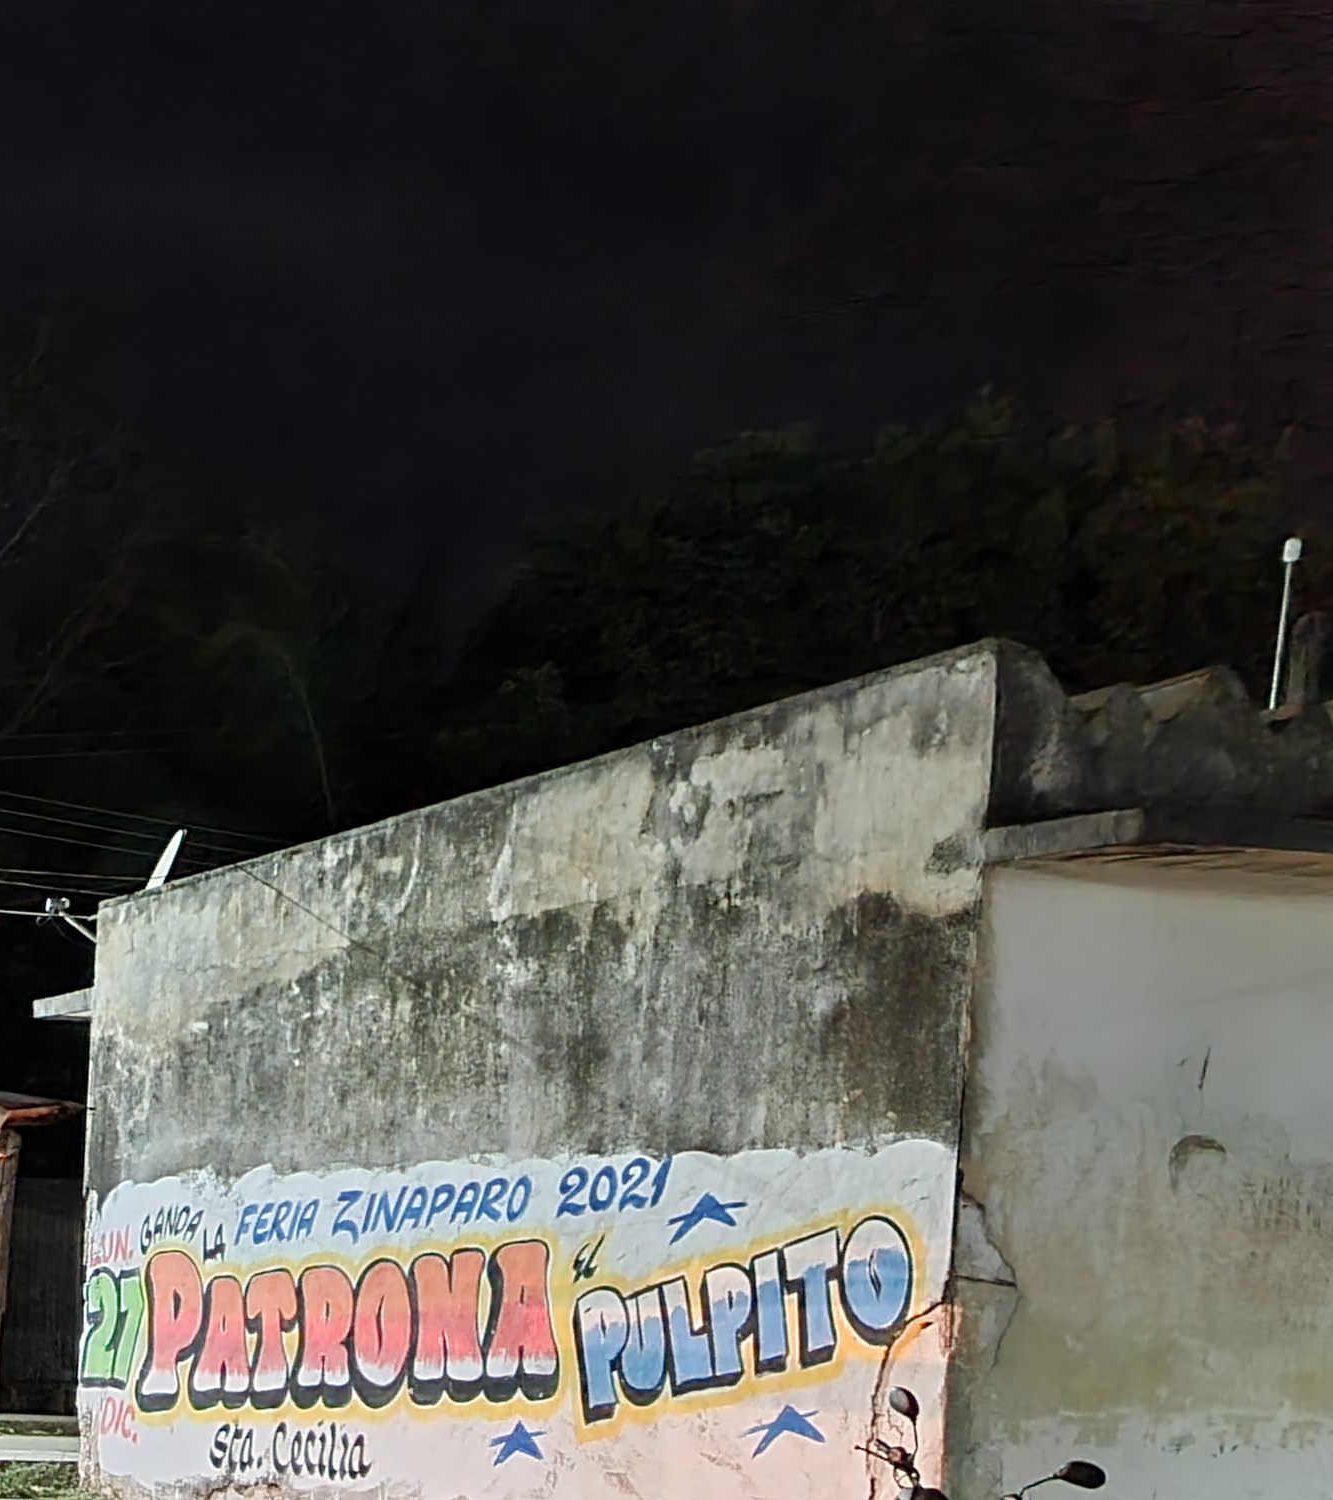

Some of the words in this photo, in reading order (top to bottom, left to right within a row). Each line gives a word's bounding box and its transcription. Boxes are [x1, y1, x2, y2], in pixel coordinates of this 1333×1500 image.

[233, 1198, 320, 1247] FERIA
[332, 1174, 533, 1245] ZINAPARO
[556, 1154, 673, 1218] 2021
[203, 1223, 226, 1265] LA
[135, 1239, 560, 1412] PATRONA
[573, 1214, 914, 1425] PULPITO
[100, 1396, 139, 1443] DIC.
[273, 1421, 373, 1481] Cecilia
